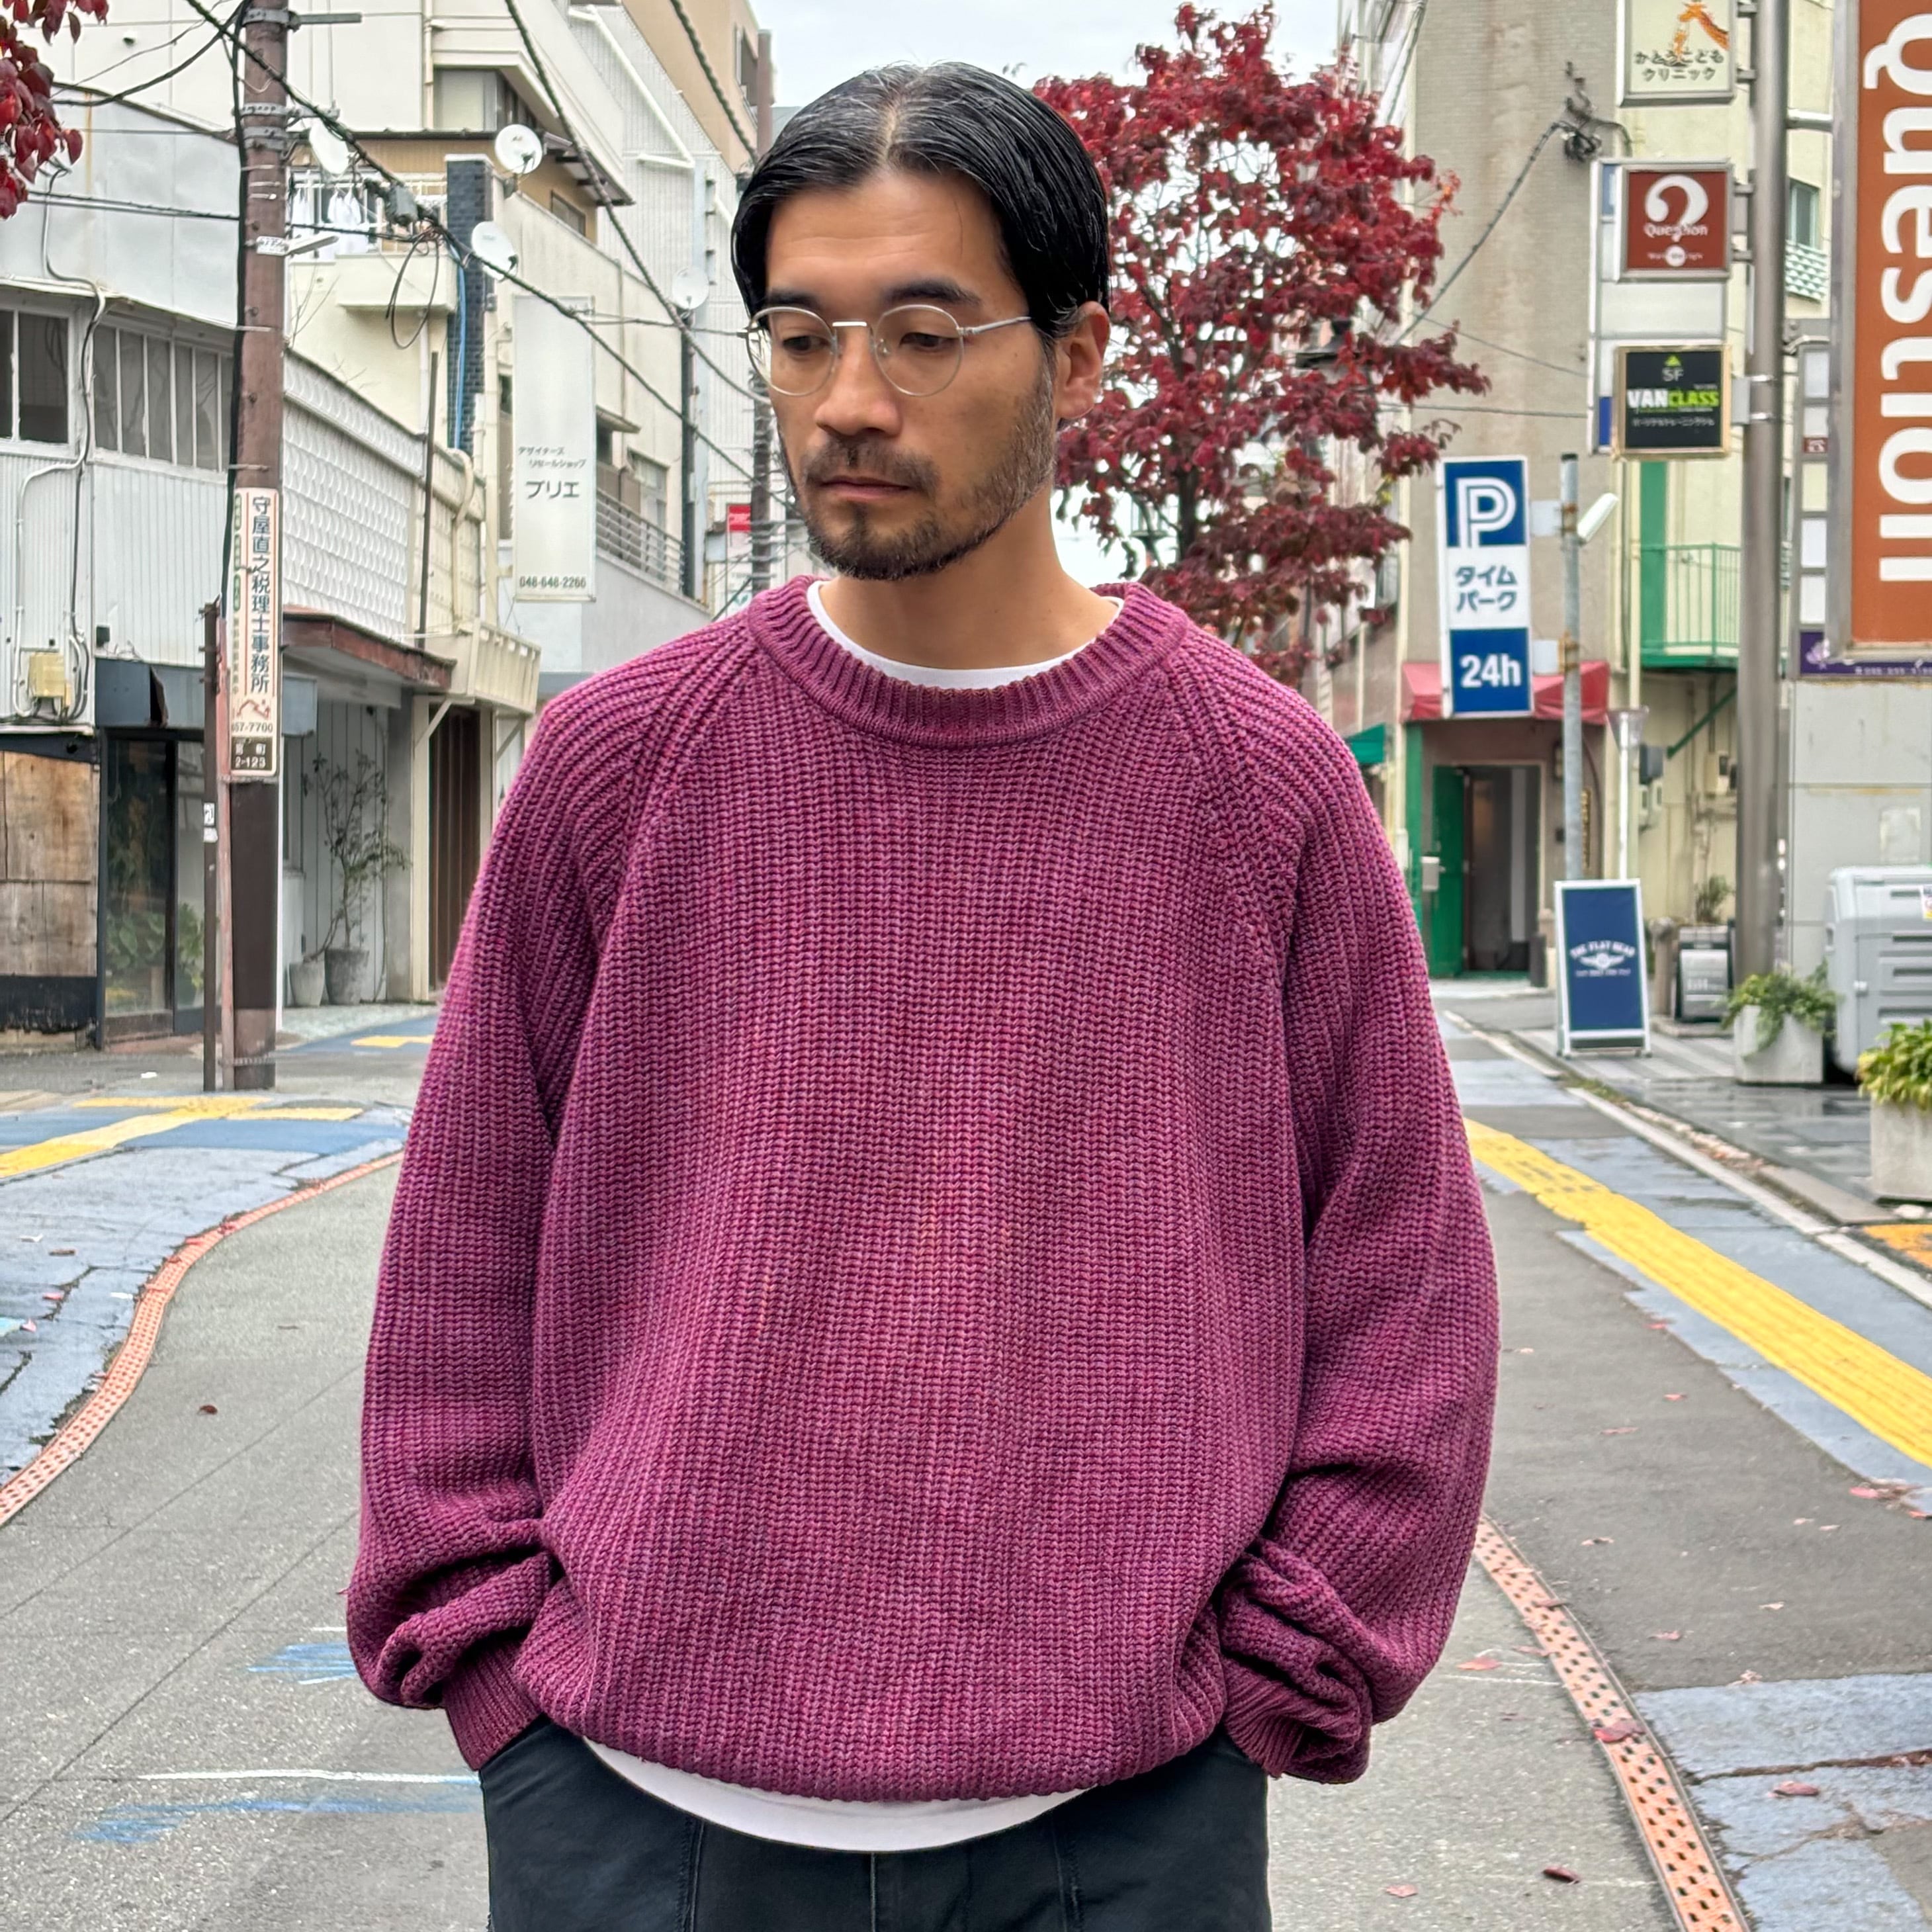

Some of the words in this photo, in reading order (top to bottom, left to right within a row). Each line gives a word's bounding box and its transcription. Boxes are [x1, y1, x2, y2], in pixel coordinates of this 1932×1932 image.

[1642, 67, 1716, 81] クリニック
[1456, 566, 1518, 587] タイム
[251, 496, 271, 693] 守屋直之税理士事務所
[1457, 590, 1517, 612] パーク
[1460, 652, 1522, 688] 24h
